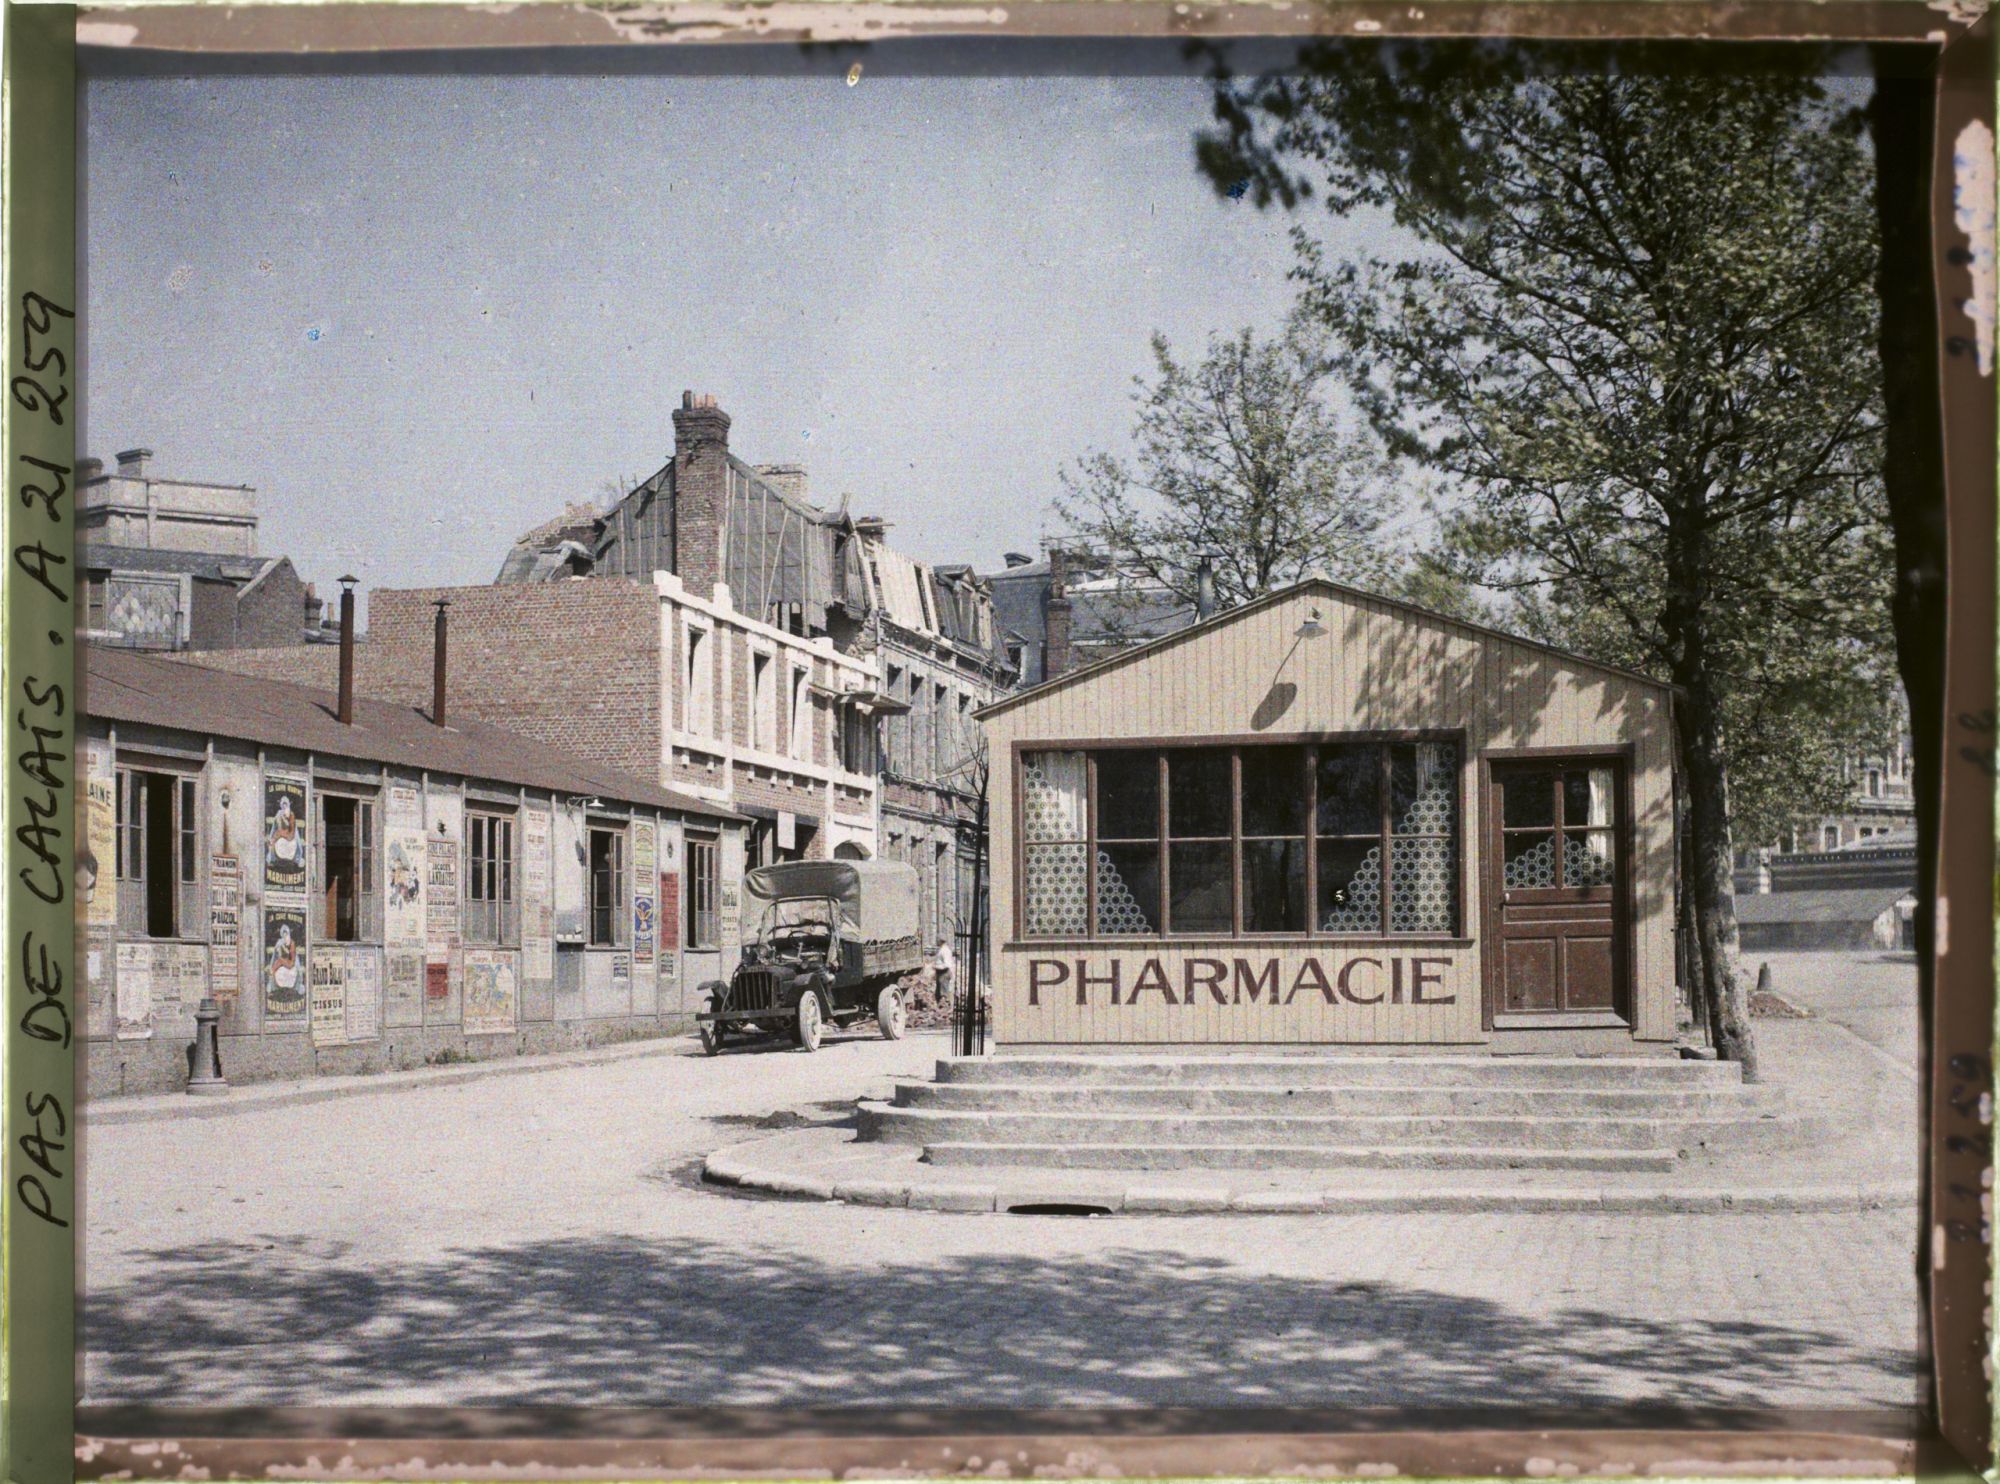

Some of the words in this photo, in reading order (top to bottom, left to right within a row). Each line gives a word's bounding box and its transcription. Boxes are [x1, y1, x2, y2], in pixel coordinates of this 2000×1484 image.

[10, 291, 74, 426] 259
[20, 455, 72, 523] 21
[14, 540, 69, 603] A
[20, 931, 72, 1050] DE
[312, 999, 343, 1010] TISSUS
[1028, 956, 1456, 1006] PHARMACIE
[17, 1091, 69, 1228] PAS
